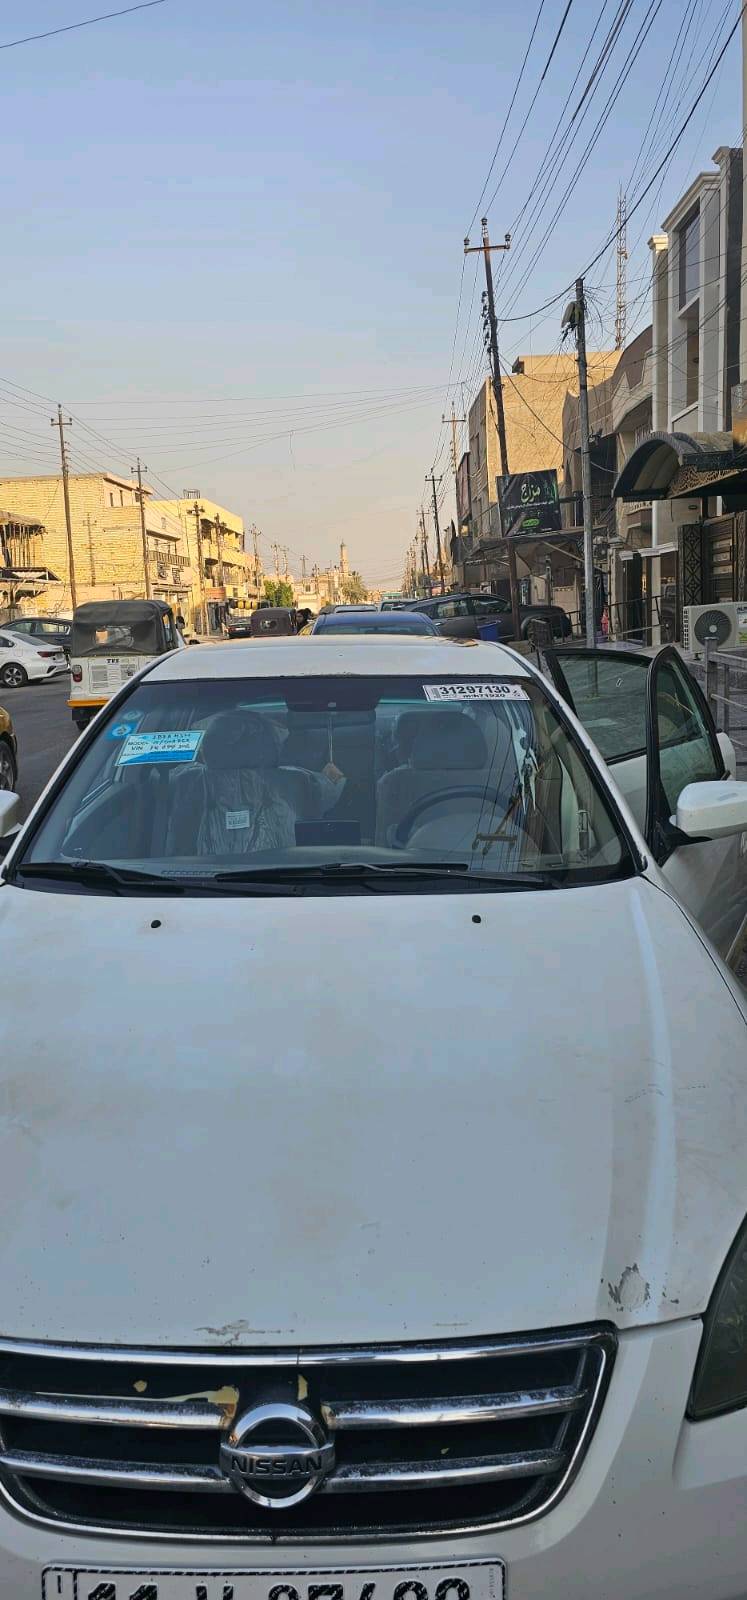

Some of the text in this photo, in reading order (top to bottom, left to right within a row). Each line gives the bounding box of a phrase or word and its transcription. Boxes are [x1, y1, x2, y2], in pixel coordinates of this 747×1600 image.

[521, 482, 541, 503] مزاج
[440, 686, 510, 694] 31297130
[231, 1456, 322, 1476] NISSAN
